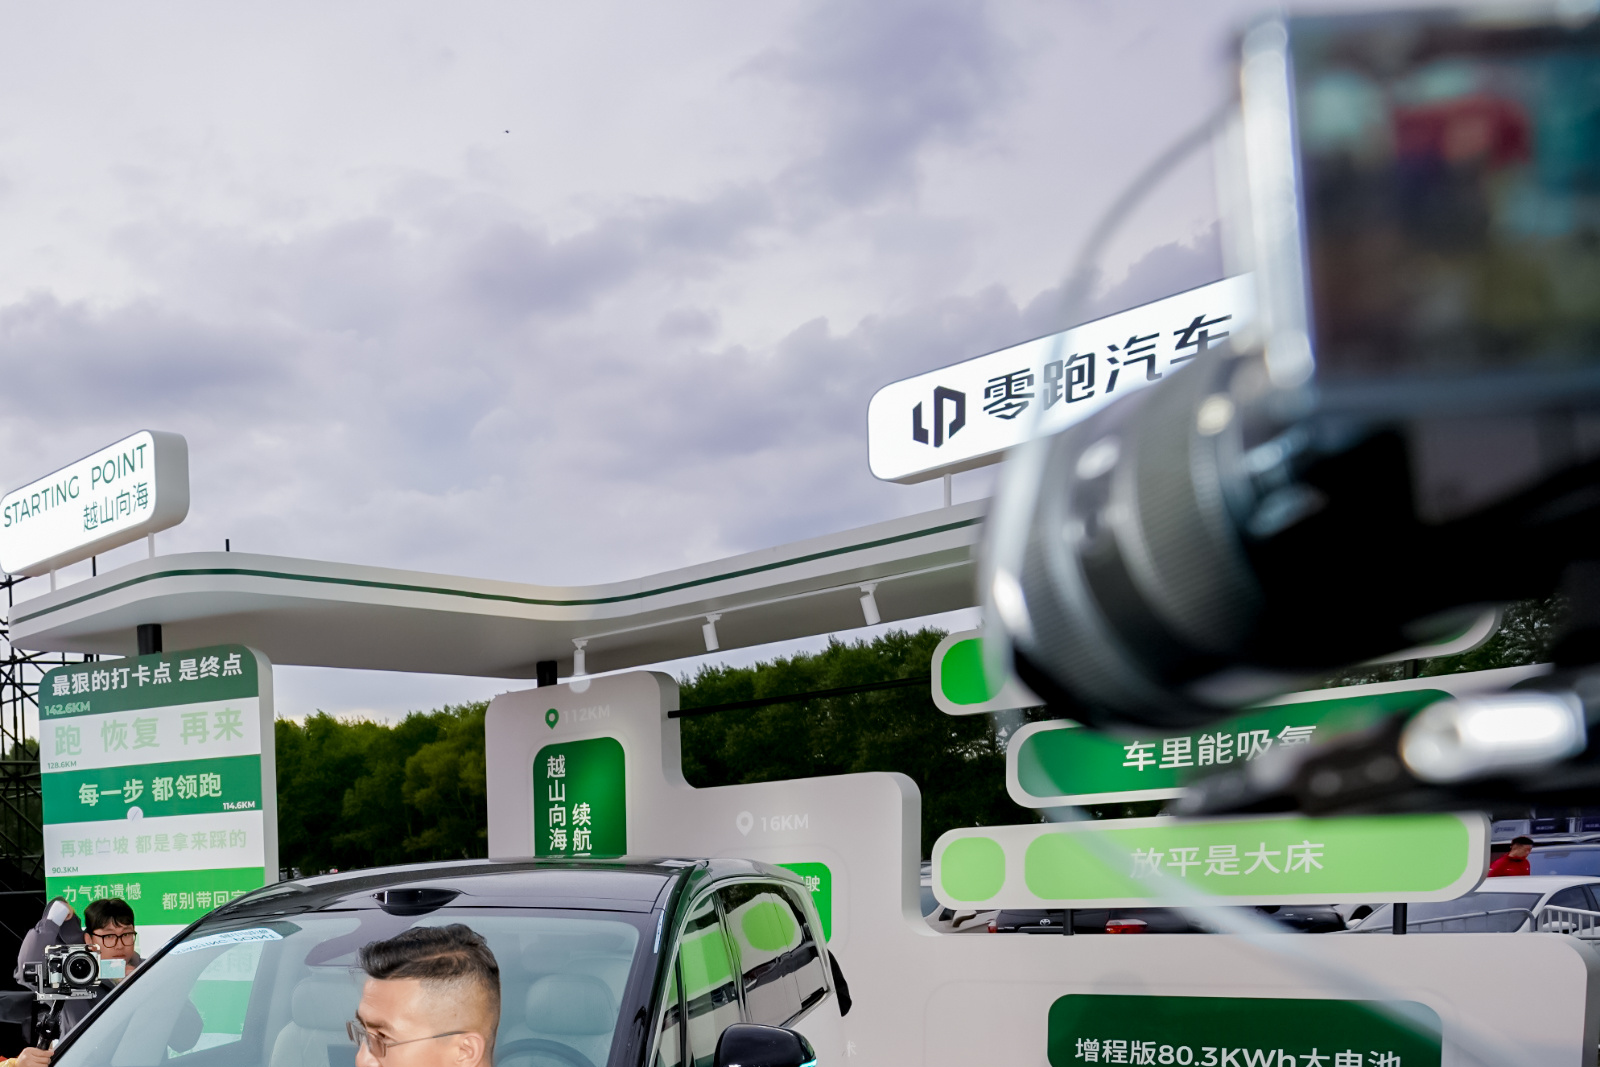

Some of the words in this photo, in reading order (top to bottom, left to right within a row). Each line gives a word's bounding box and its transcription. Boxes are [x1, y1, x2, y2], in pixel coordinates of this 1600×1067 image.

[983, 314, 1232, 420] 零跑汽车
[4, 475, 80, 528] STARTING
[91, 443, 147, 490] POINT
[83, 482, 149, 532] 越山向海
[52, 662, 172, 697] 最狠的打卡点
[179, 653, 243, 682] 是终点
[45, 701, 91, 716] 142.6KM
[563, 704, 610, 724] 112KM
[54, 724, 82, 757] 跑
[100, 717, 160, 753] 恢复
[180, 707, 244, 746] 再来
[47, 760, 77, 769] 128.6KM
[79, 778, 144, 807] 每一步
[152, 773, 222, 802] 都领跑
[222, 800, 256, 810] 114.6KM
[547, 754, 567, 850] 越山向海
[572, 802, 592, 857] 续航
[760, 813, 809, 832] 16KM
[135, 829, 247, 854] 都是拿来踩的
[1130, 840, 1325, 879] 放平是大床
[52, 866, 79, 874] 90.3KM
